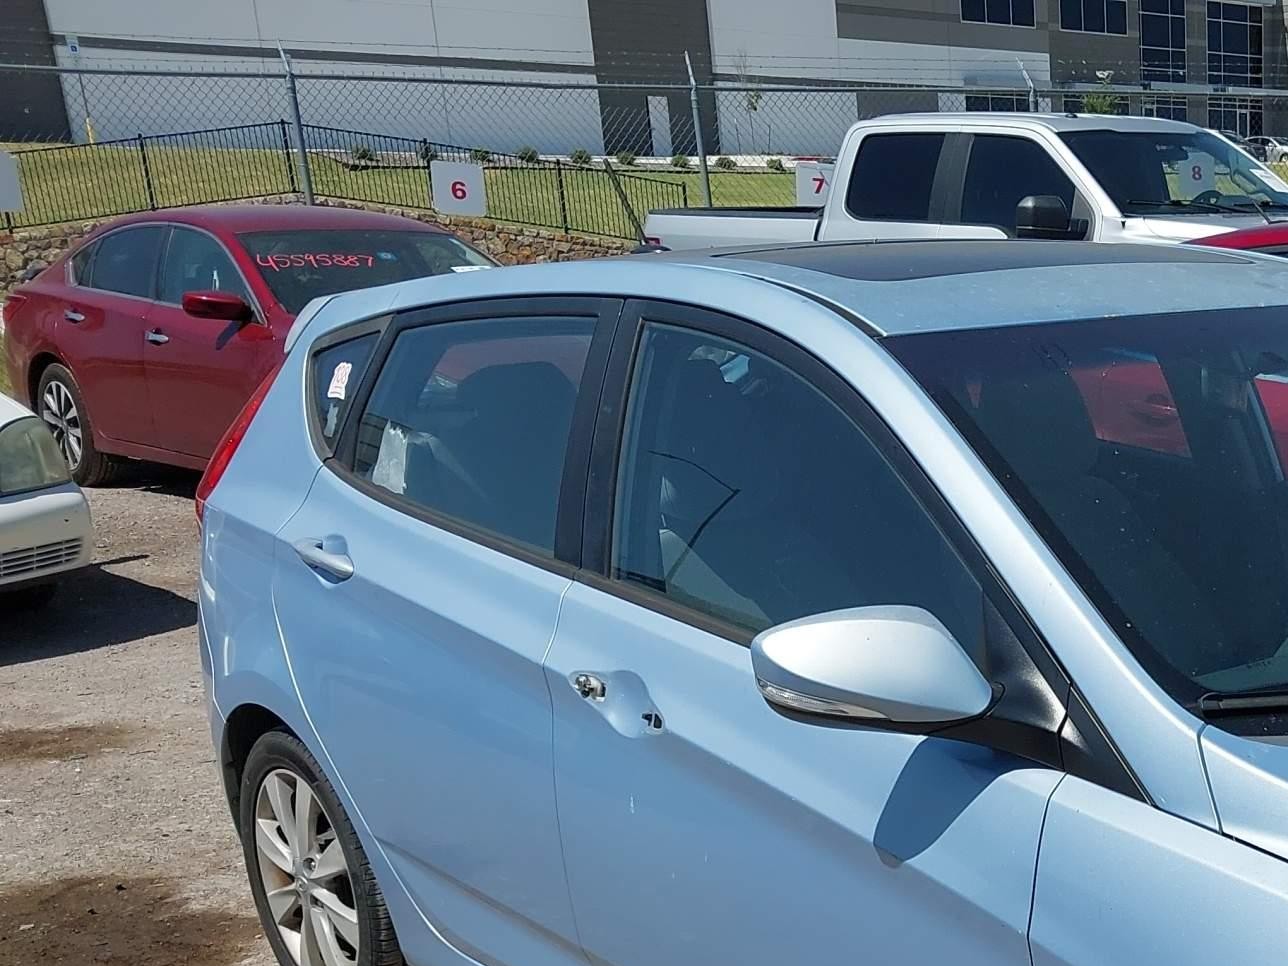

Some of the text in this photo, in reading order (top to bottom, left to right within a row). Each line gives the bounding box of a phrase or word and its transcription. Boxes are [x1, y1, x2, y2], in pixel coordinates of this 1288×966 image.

[1192, 165, 1202, 181] 8
[451, 181, 467, 200] 6
[812, 177, 825, 194] 7
[256, 253, 374, 271] 45595887
